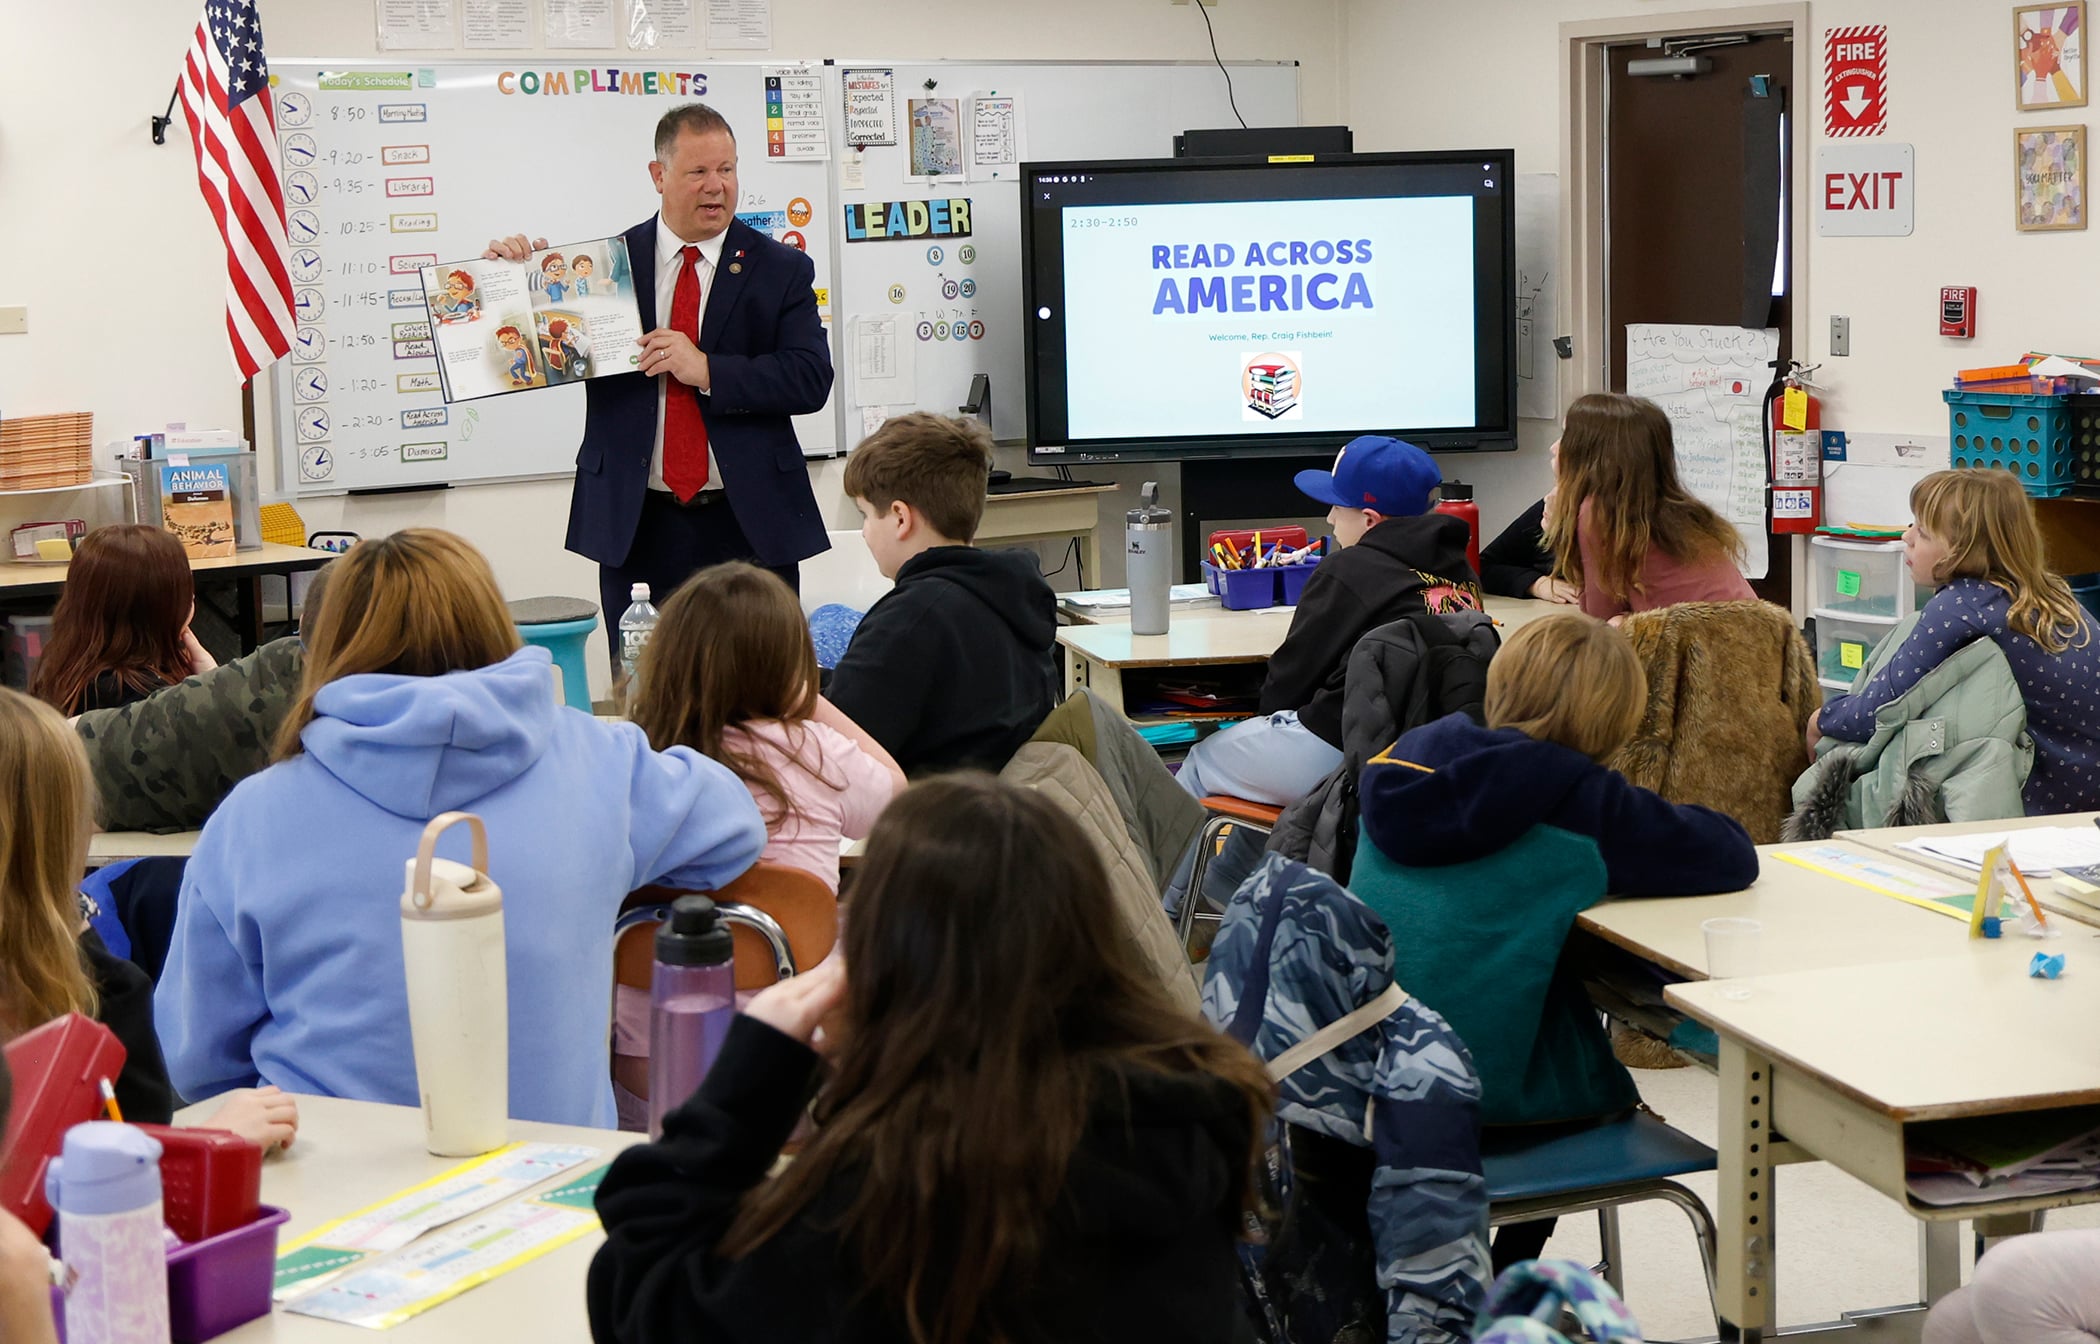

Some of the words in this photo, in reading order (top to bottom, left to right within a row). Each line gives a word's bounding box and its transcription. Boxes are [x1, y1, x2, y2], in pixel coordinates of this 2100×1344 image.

[1836, 42, 1876, 61] FIRE
[1835, 67, 1877, 82] EXTINGUISHER
[324, 77, 360, 87] Today's
[364, 76, 409, 86] Schedule
[497, 69, 708, 96] COMPLIMENTS
[769, 78, 777, 87] 0
[771, 92, 777, 100] 1
[848, 93, 884, 103] Expected
[331, 105, 366, 121] 8:50
[771, 105, 778, 114] 2
[772, 132, 780, 140] 4
[850, 132, 885, 141] Corrected
[330, 150, 363, 165] 9:20
[391, 150, 418, 161] Snack
[333, 179, 363, 193] 9:35
[393, 181, 429, 193] Library
[1825, 172, 1903, 210] EXIT
[398, 218, 431, 228] Reading
[743, 215, 771, 227] eather
[846, 198, 971, 240] LEADER
[1071, 217, 1138, 228] 2:30-2:50
[340, 221, 375, 235] 10:25
[933, 251, 939, 260] 8
[963, 250, 973, 259] 10
[1152, 242, 1235, 269] READ
[1244, 239, 1373, 267] ACROSS
[342, 262, 377, 275] 11:10
[893, 288, 903, 298] 16
[946, 285, 956, 294] 19
[963, 283, 973, 293] 20
[343, 292, 377, 306] 11:45
[1152, 272, 1374, 316] AMERICA
[1942, 289, 1966, 300] FIRE
[922, 327, 928, 335] 5
[939, 326, 945, 335] 3
[956, 326, 966, 335] 15
[974, 325, 979, 334] 7
[1208, 333, 1249, 342] Welcome,
[1252, 333, 1270, 341] Rep.
[1272, 331, 1294, 340] Craig
[1296, 330, 1333, 339] Fishbein!
[1643, 328, 1667, 347] Are
[1672, 329, 1693, 349] You
[342, 335, 375, 349] 12:50
[405, 342, 427, 350] Read
[351, 379, 377, 392] 1:20
[410, 378, 432, 388] Math
[352, 416, 382, 428] 2:20
[360, 446, 389, 459] 3:05
[170, 469, 223, 482] ANIMAL
[171, 480, 223, 491] BEHAVIOR
